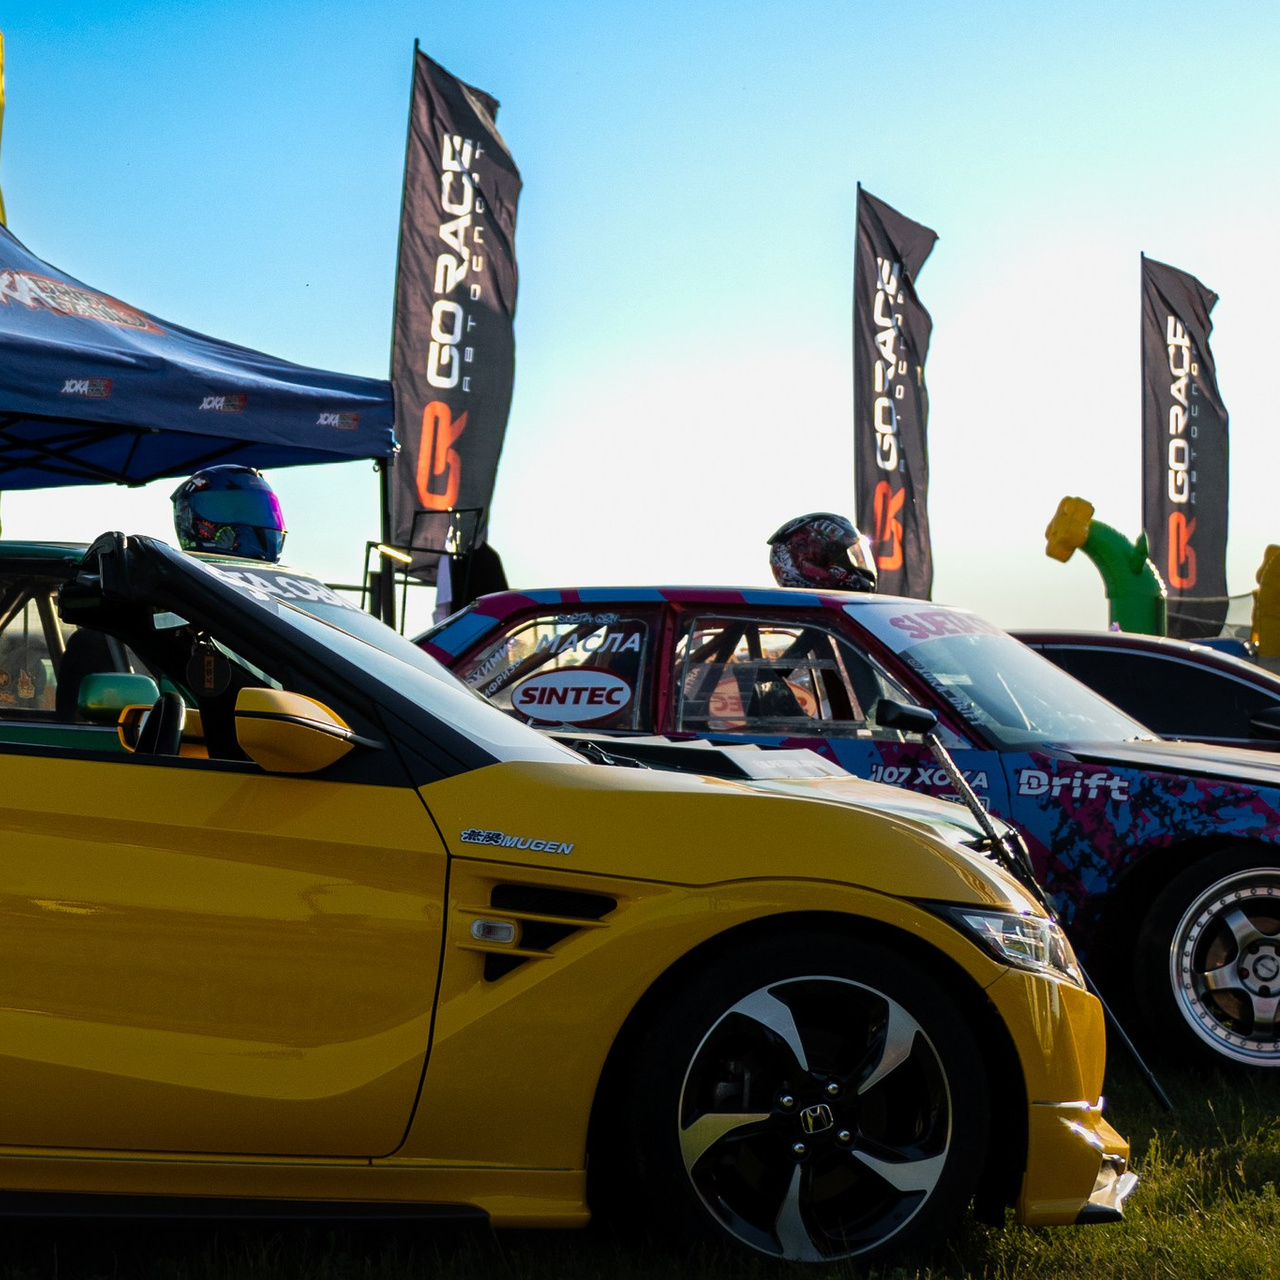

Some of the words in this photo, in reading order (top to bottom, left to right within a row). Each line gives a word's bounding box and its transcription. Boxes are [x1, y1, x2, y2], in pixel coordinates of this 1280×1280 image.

[535, 632, 640, 654] МАСЛА
[519, 686, 624, 705] SINTEC
[1018, 769, 1130, 801] Drift
[501, 835, 574, 855] MUGEN
